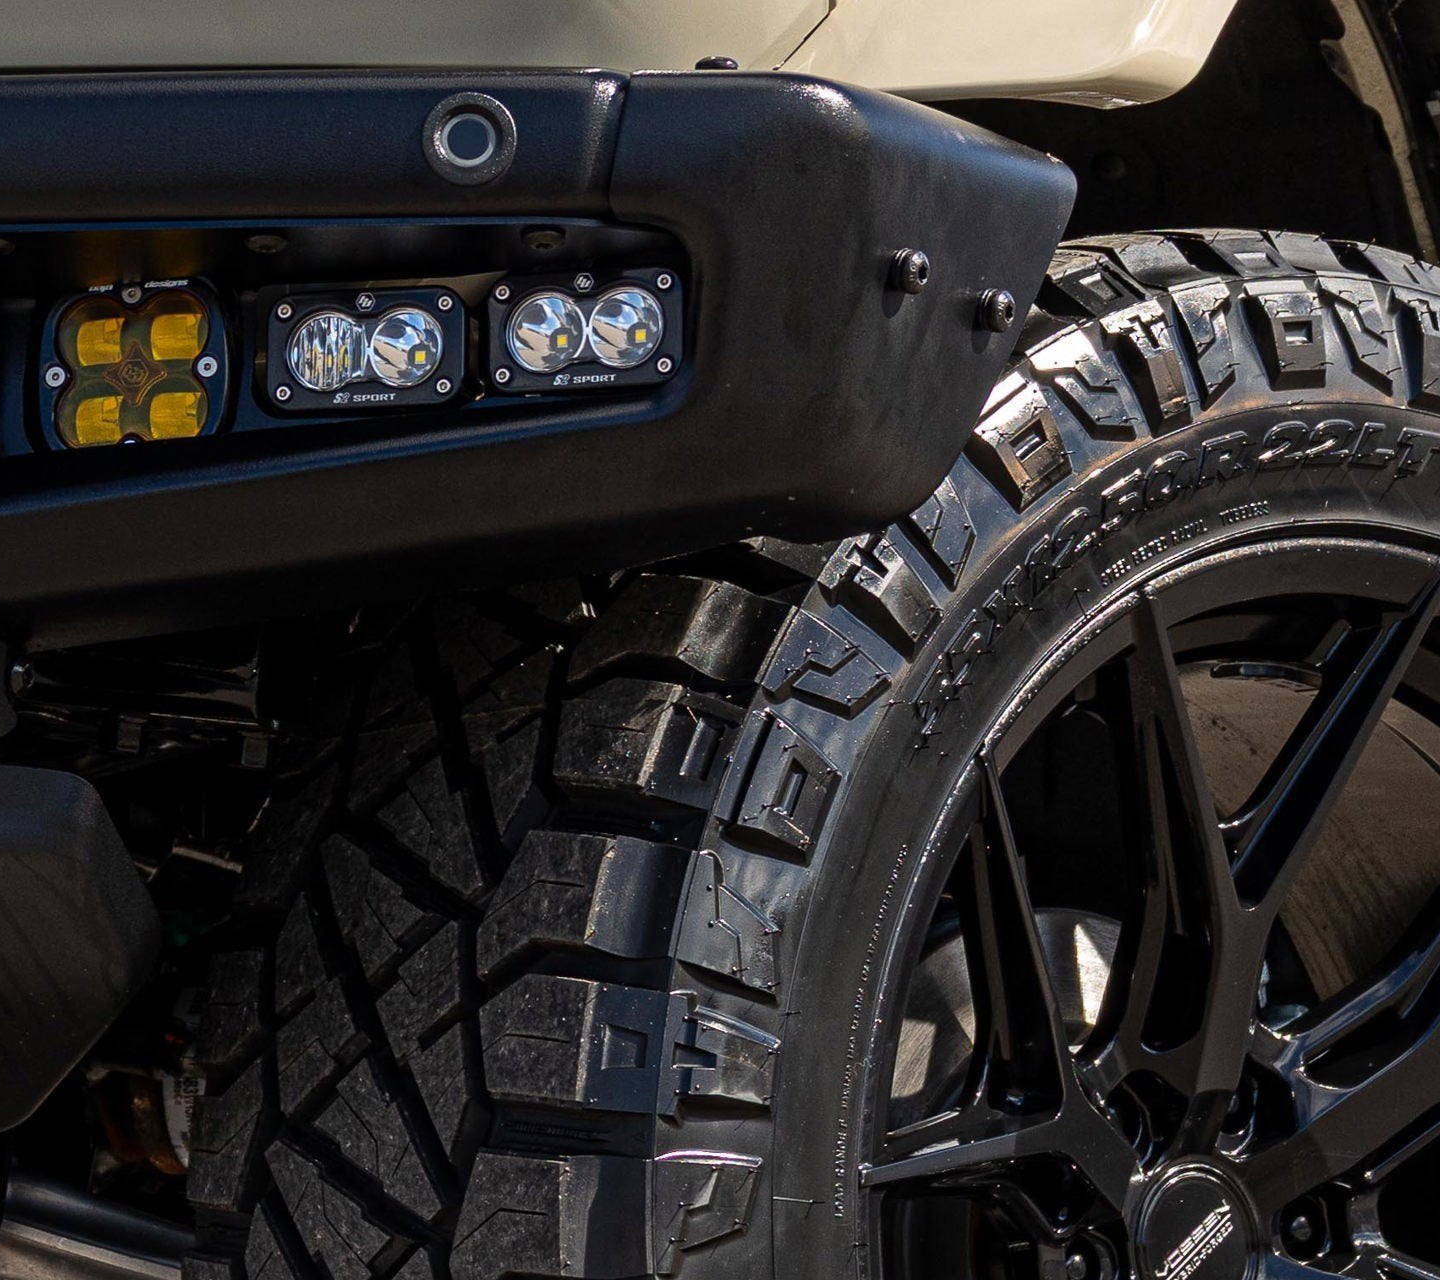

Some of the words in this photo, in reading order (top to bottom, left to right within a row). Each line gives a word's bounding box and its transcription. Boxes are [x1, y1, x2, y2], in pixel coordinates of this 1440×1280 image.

[573, 374, 616, 384] SPORT
[353, 392, 397, 402] SPORT
[1155, 1199, 1231, 1277] VOSSEN
